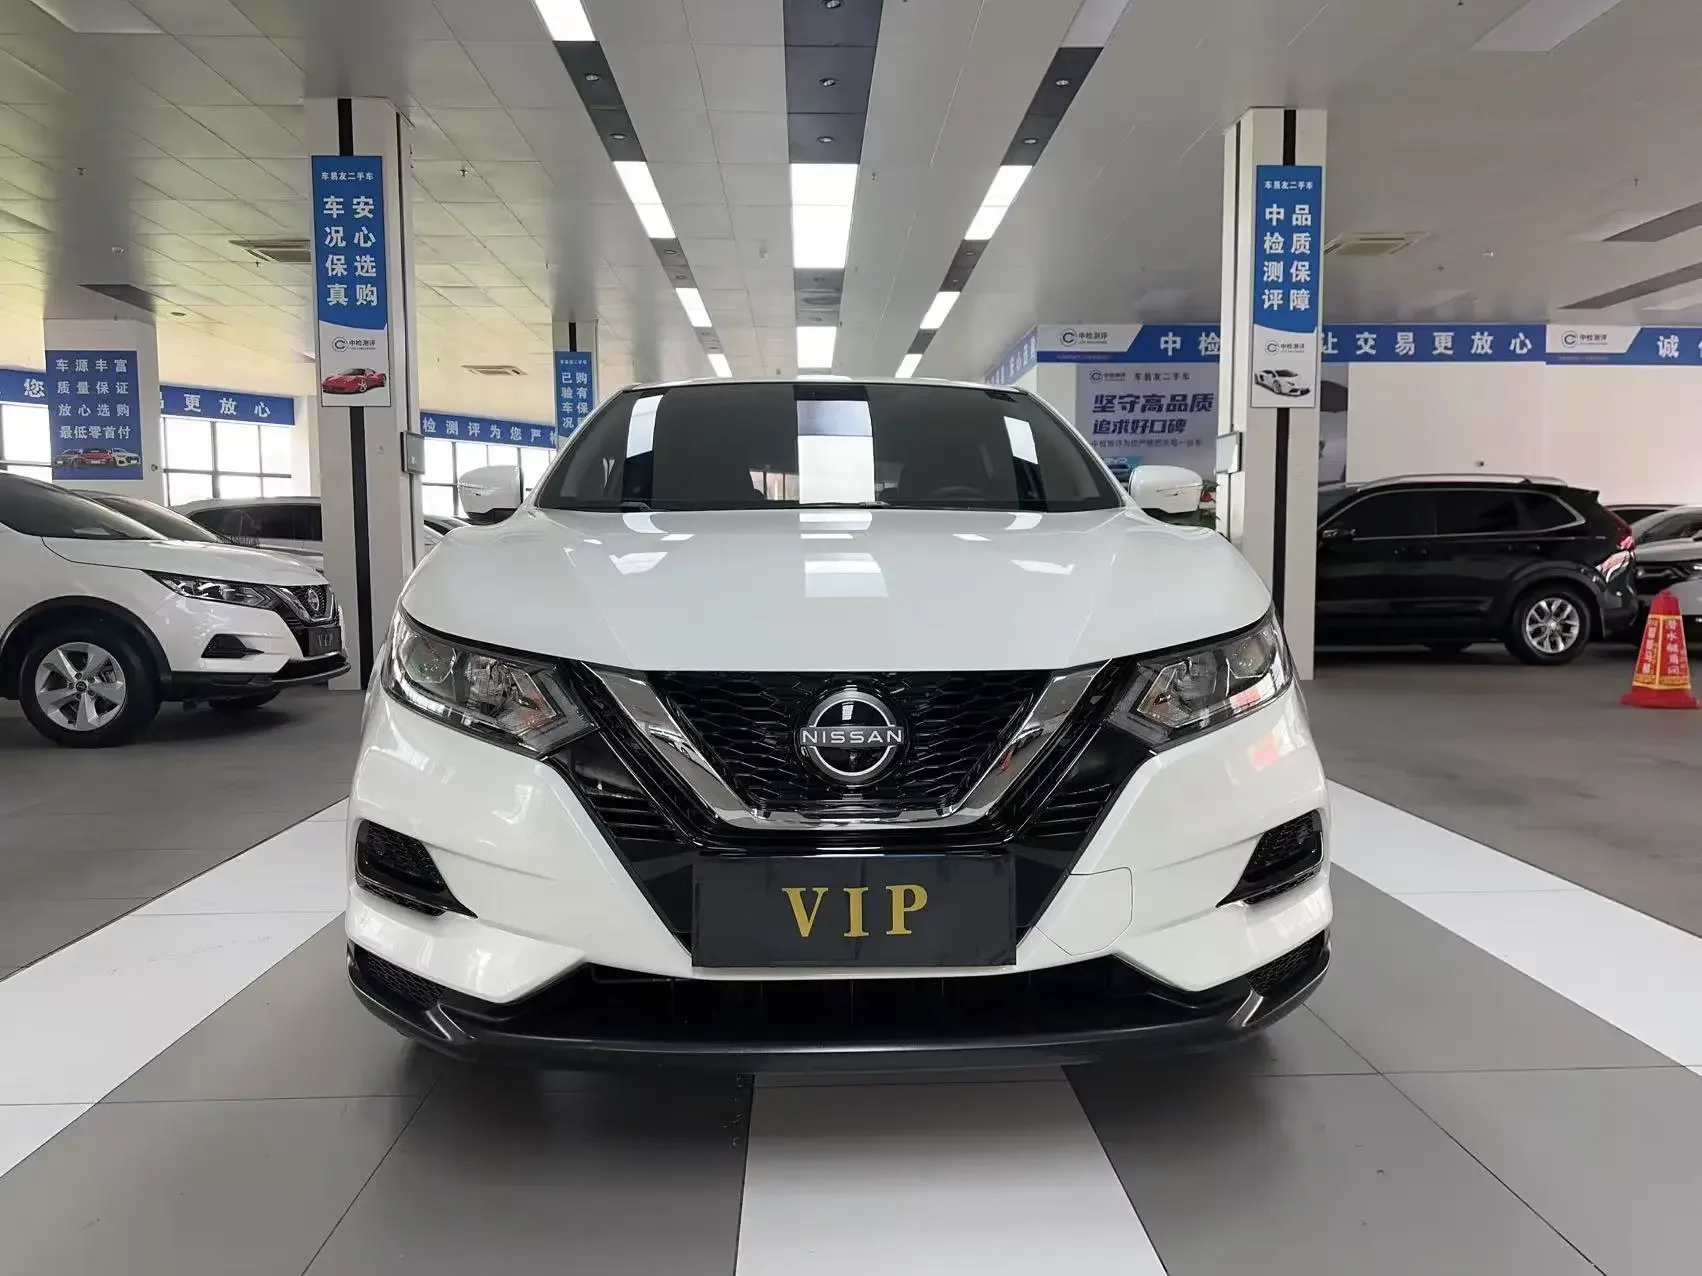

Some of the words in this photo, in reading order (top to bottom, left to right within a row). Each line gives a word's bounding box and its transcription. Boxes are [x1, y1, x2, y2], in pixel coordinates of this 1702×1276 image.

[323, 195, 349, 307] 车况保真
[352, 195, 378, 307] 安心选购
[1262, 204, 1285, 311] 中检测评
[1289, 204, 1312, 311] 品质保障
[56, 359, 128, 372] 车源丰富
[57, 381, 129, 394] 质量保证
[59, 403, 130, 417] 放心选购
[159, 391, 271, 418] 更放心
[561, 372, 574, 429] 已验车况
[1092, 392, 1214, 413] 坚守高品质
[60, 426, 131, 439] 最低零首付
[1093, 418, 1187, 434] 追求好口碑
[802, 729, 903, 744] NISSAN
[781, 884, 929, 938] VIP
